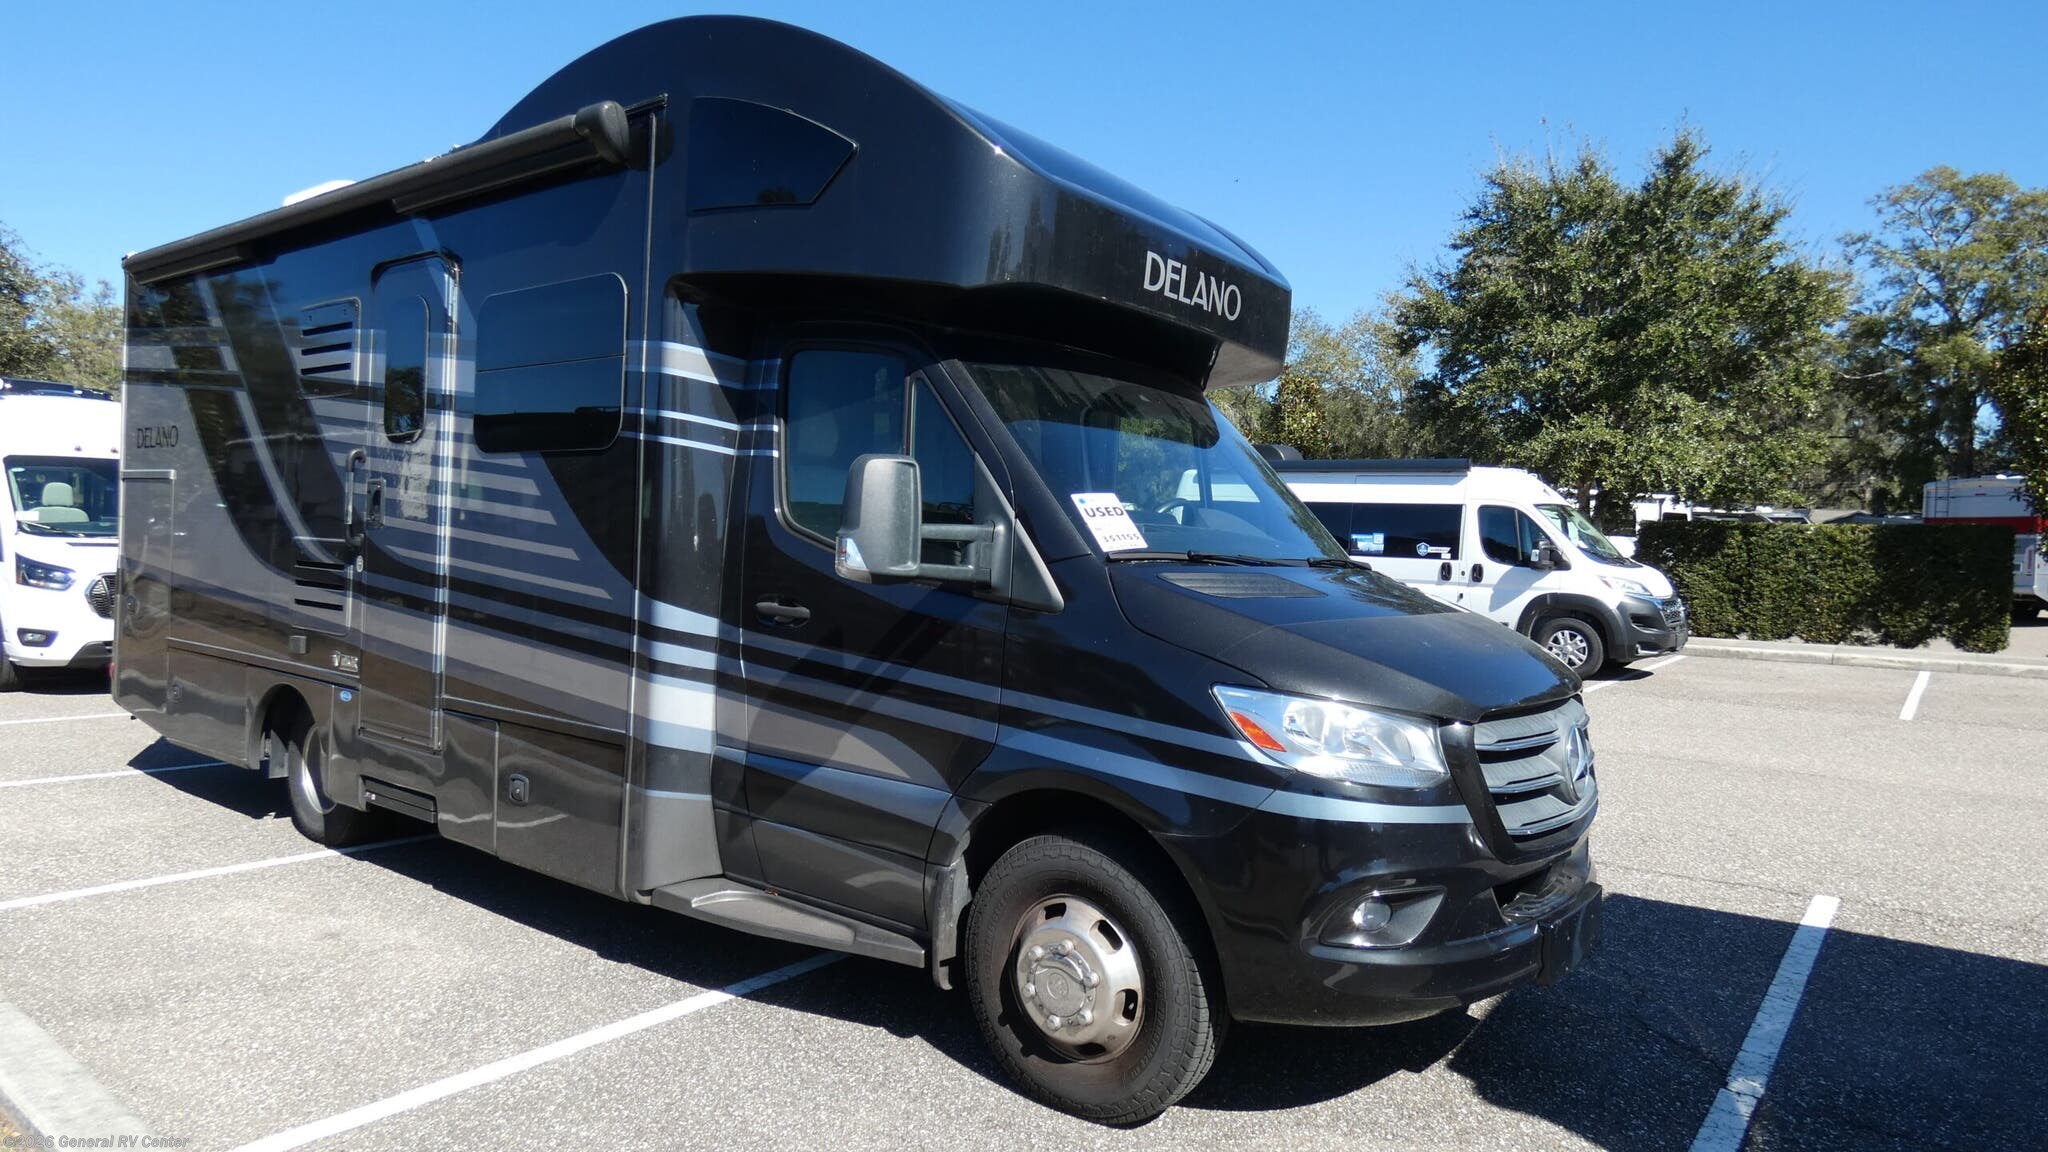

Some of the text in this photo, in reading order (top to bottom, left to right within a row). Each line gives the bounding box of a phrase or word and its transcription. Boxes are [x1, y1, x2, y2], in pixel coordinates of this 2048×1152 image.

[1143, 250, 1242, 321] DELANO
[136, 425, 179, 449] DELANO
[1083, 506, 1125, 518] USED
